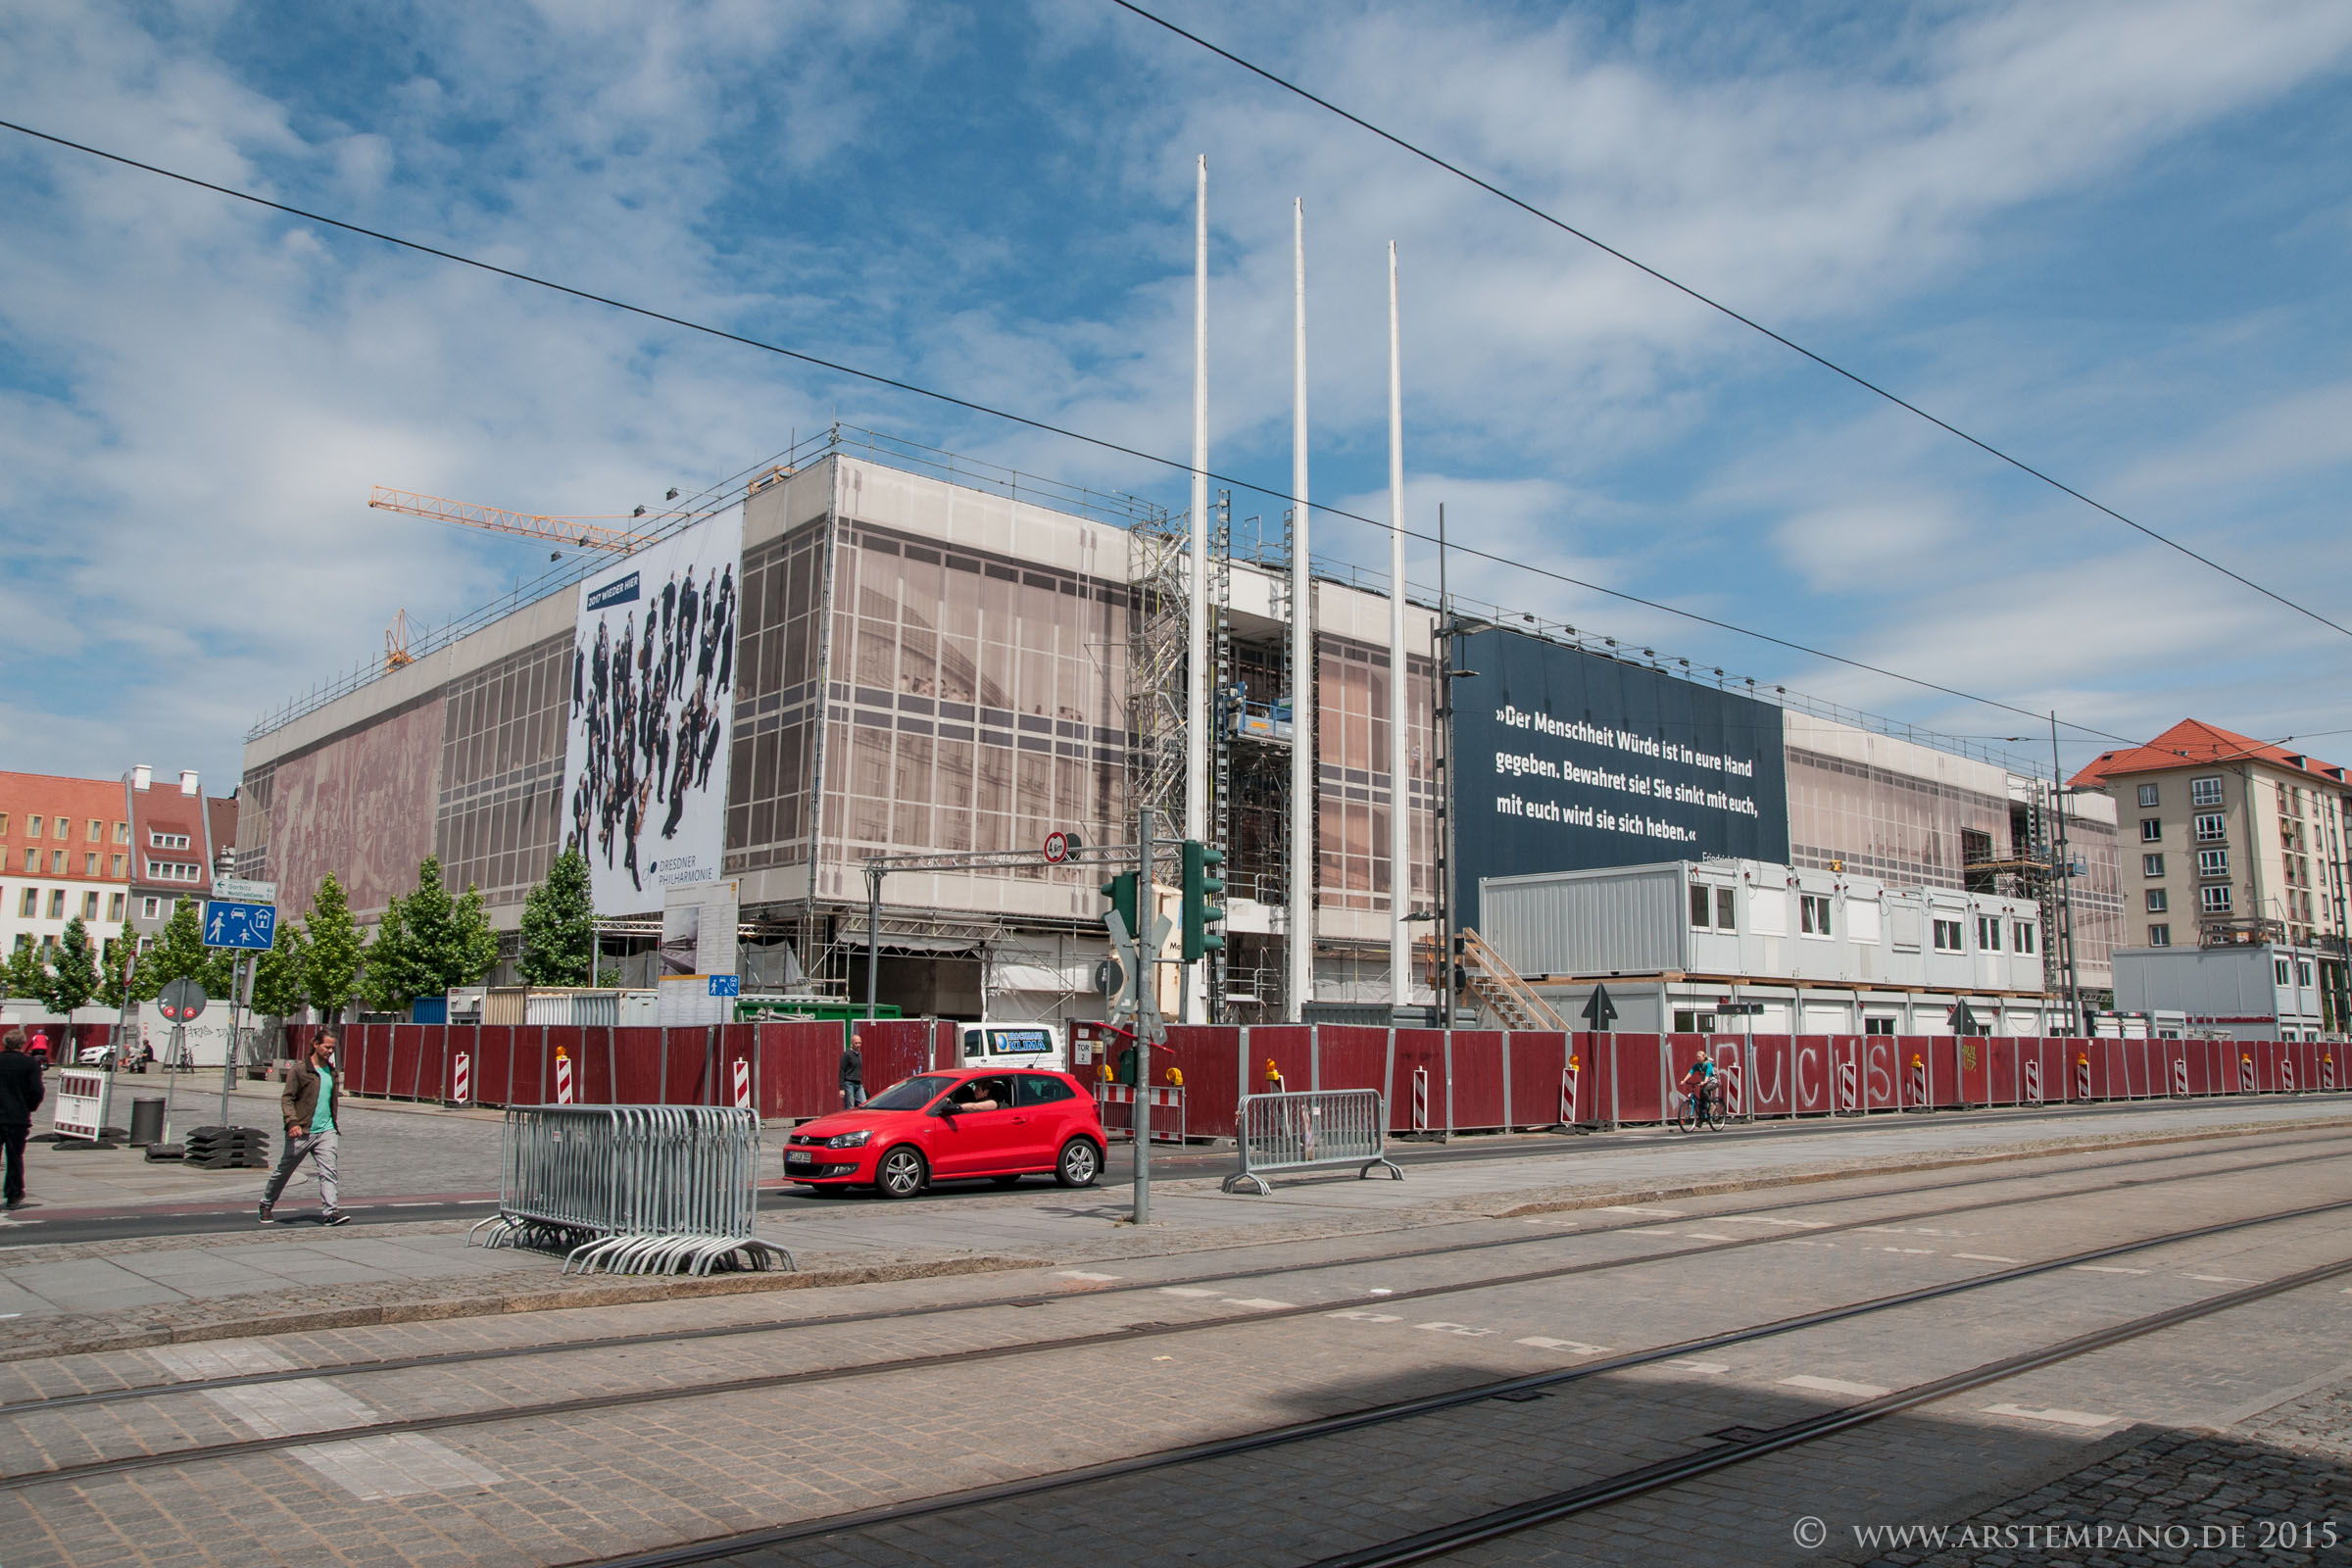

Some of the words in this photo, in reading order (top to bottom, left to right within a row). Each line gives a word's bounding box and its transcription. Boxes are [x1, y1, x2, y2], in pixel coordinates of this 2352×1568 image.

[588, 593, 601, 607] 2017
[602, 583, 624, 601] WIEDER
[624, 576, 638, 590] HIER
[1495, 705, 1531, 729] »Der
[1534, 711, 1614, 748] Menschheit
[1616, 729, 1660, 758] Würde
[1662, 740, 1679, 761] ist
[1681, 744, 1693, 764] in
[1694, 752, 1722, 770] eure
[1724, 754, 1753, 777] Hand
[1495, 751, 1561, 779] gegeben.
[1563, 760, 1627, 792] Bewahret
[1628, 773, 1650, 796] sie!
[1653, 777, 1673, 800] Sie
[1674, 783, 1705, 806] sinkt
[1706, 790, 1728, 809] mit
[1729, 796, 1758, 818] euch,
[1496, 793, 1523, 816] mit
[1525, 800, 1560, 822] euch
[1562, 804, 1593, 827] wird
[1595, 808, 1615, 831] sie
[1618, 812, 1644, 835] sich
[1646, 816, 1696, 842] heben.«
[660, 855, 697, 872] DRESDNER
[227, 883, 252, 892] Gorbitz
[659, 867, 713, 886] PHILHARMONIE
[1008, 1040, 1047, 1052] KLIMA
